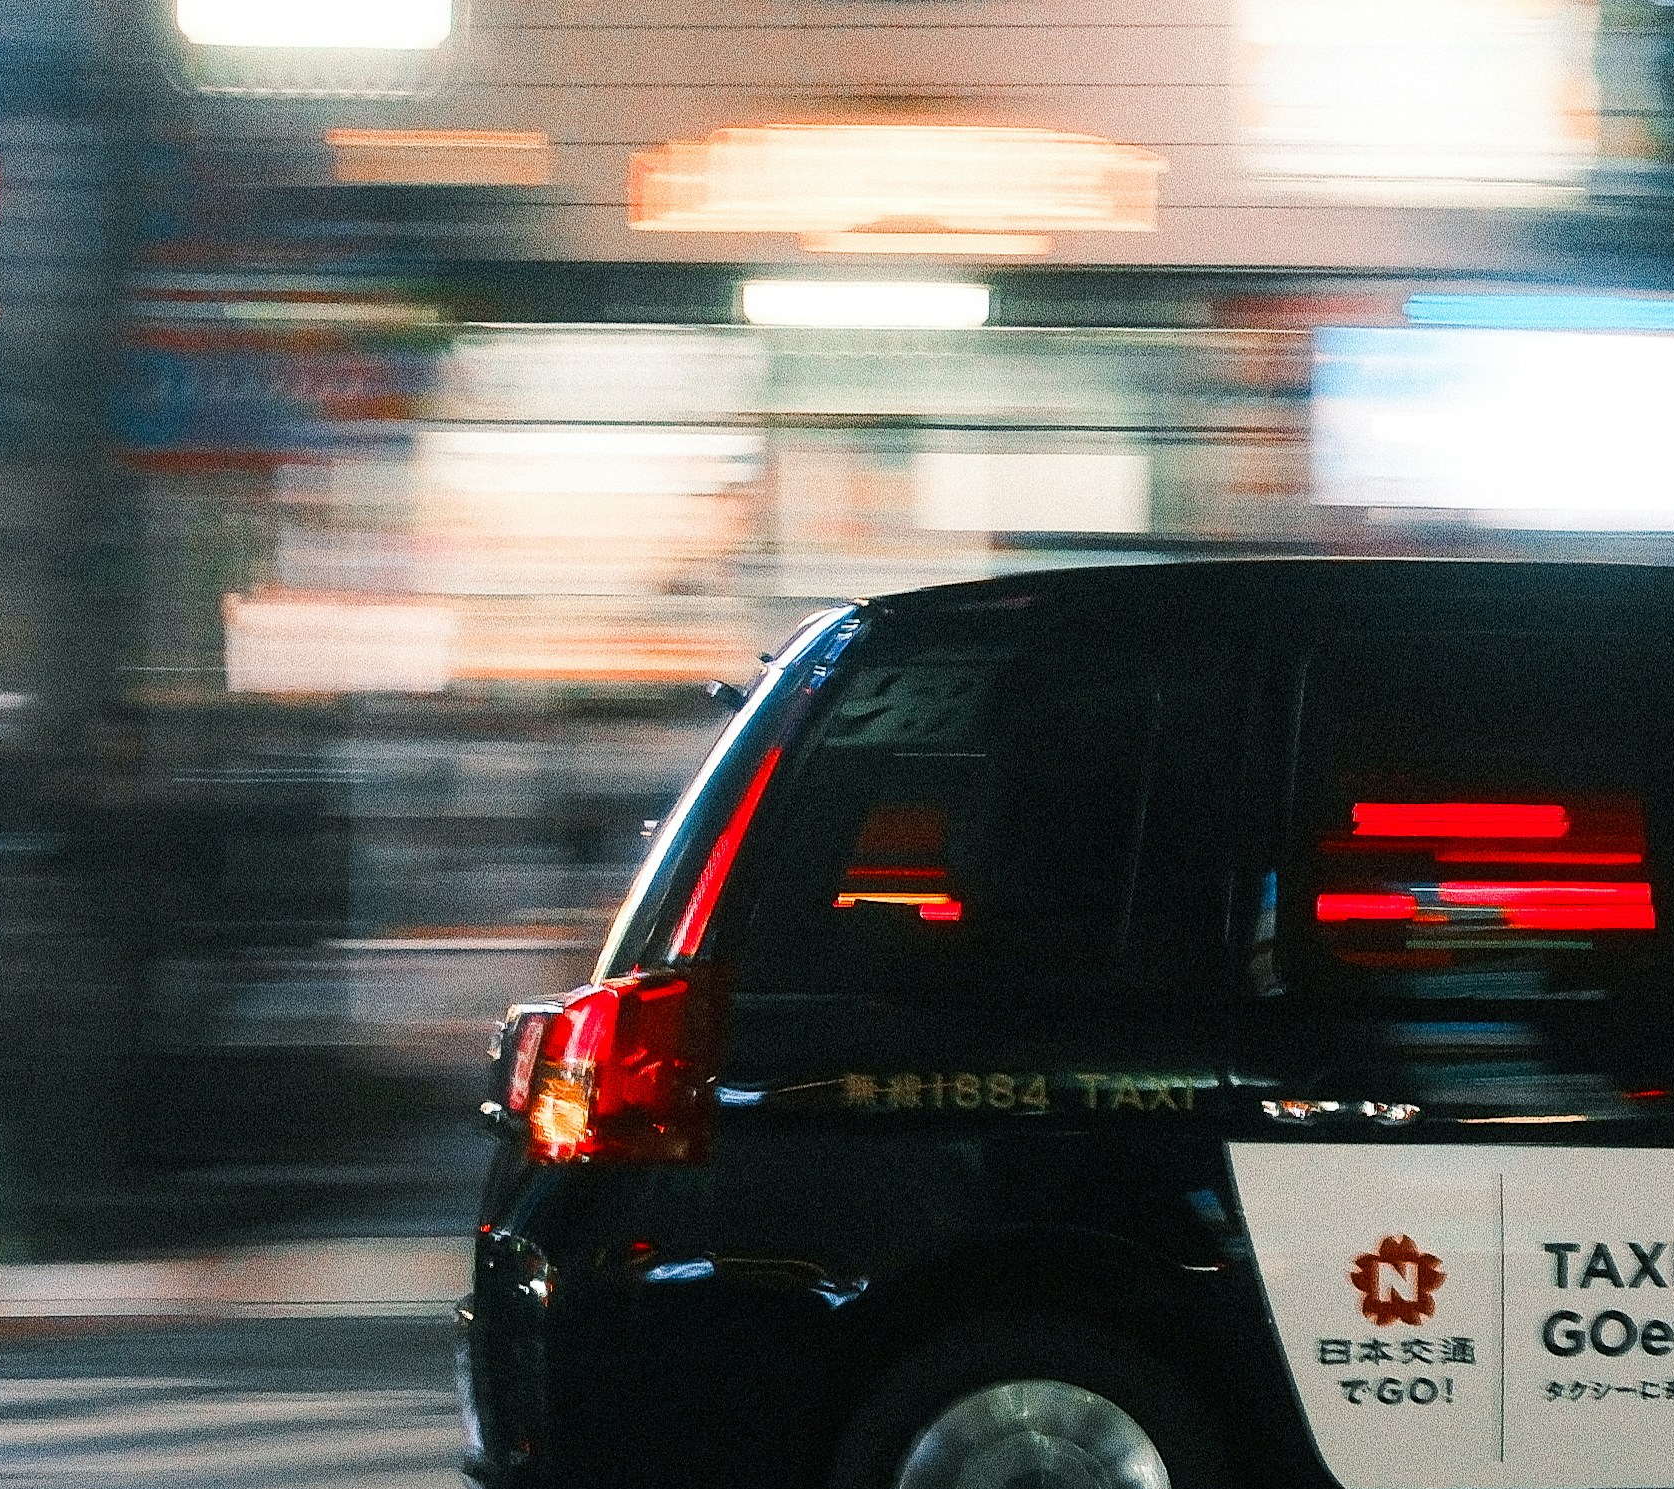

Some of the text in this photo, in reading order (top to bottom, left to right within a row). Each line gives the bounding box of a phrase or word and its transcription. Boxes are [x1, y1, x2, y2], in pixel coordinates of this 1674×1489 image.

[1076, 1072, 1195, 1111] TAXI
[1378, 1261, 1419, 1303] N
[1319, 1337, 1476, 1365] 日本交通
[1338, 1376, 1454, 1405] でGO!
